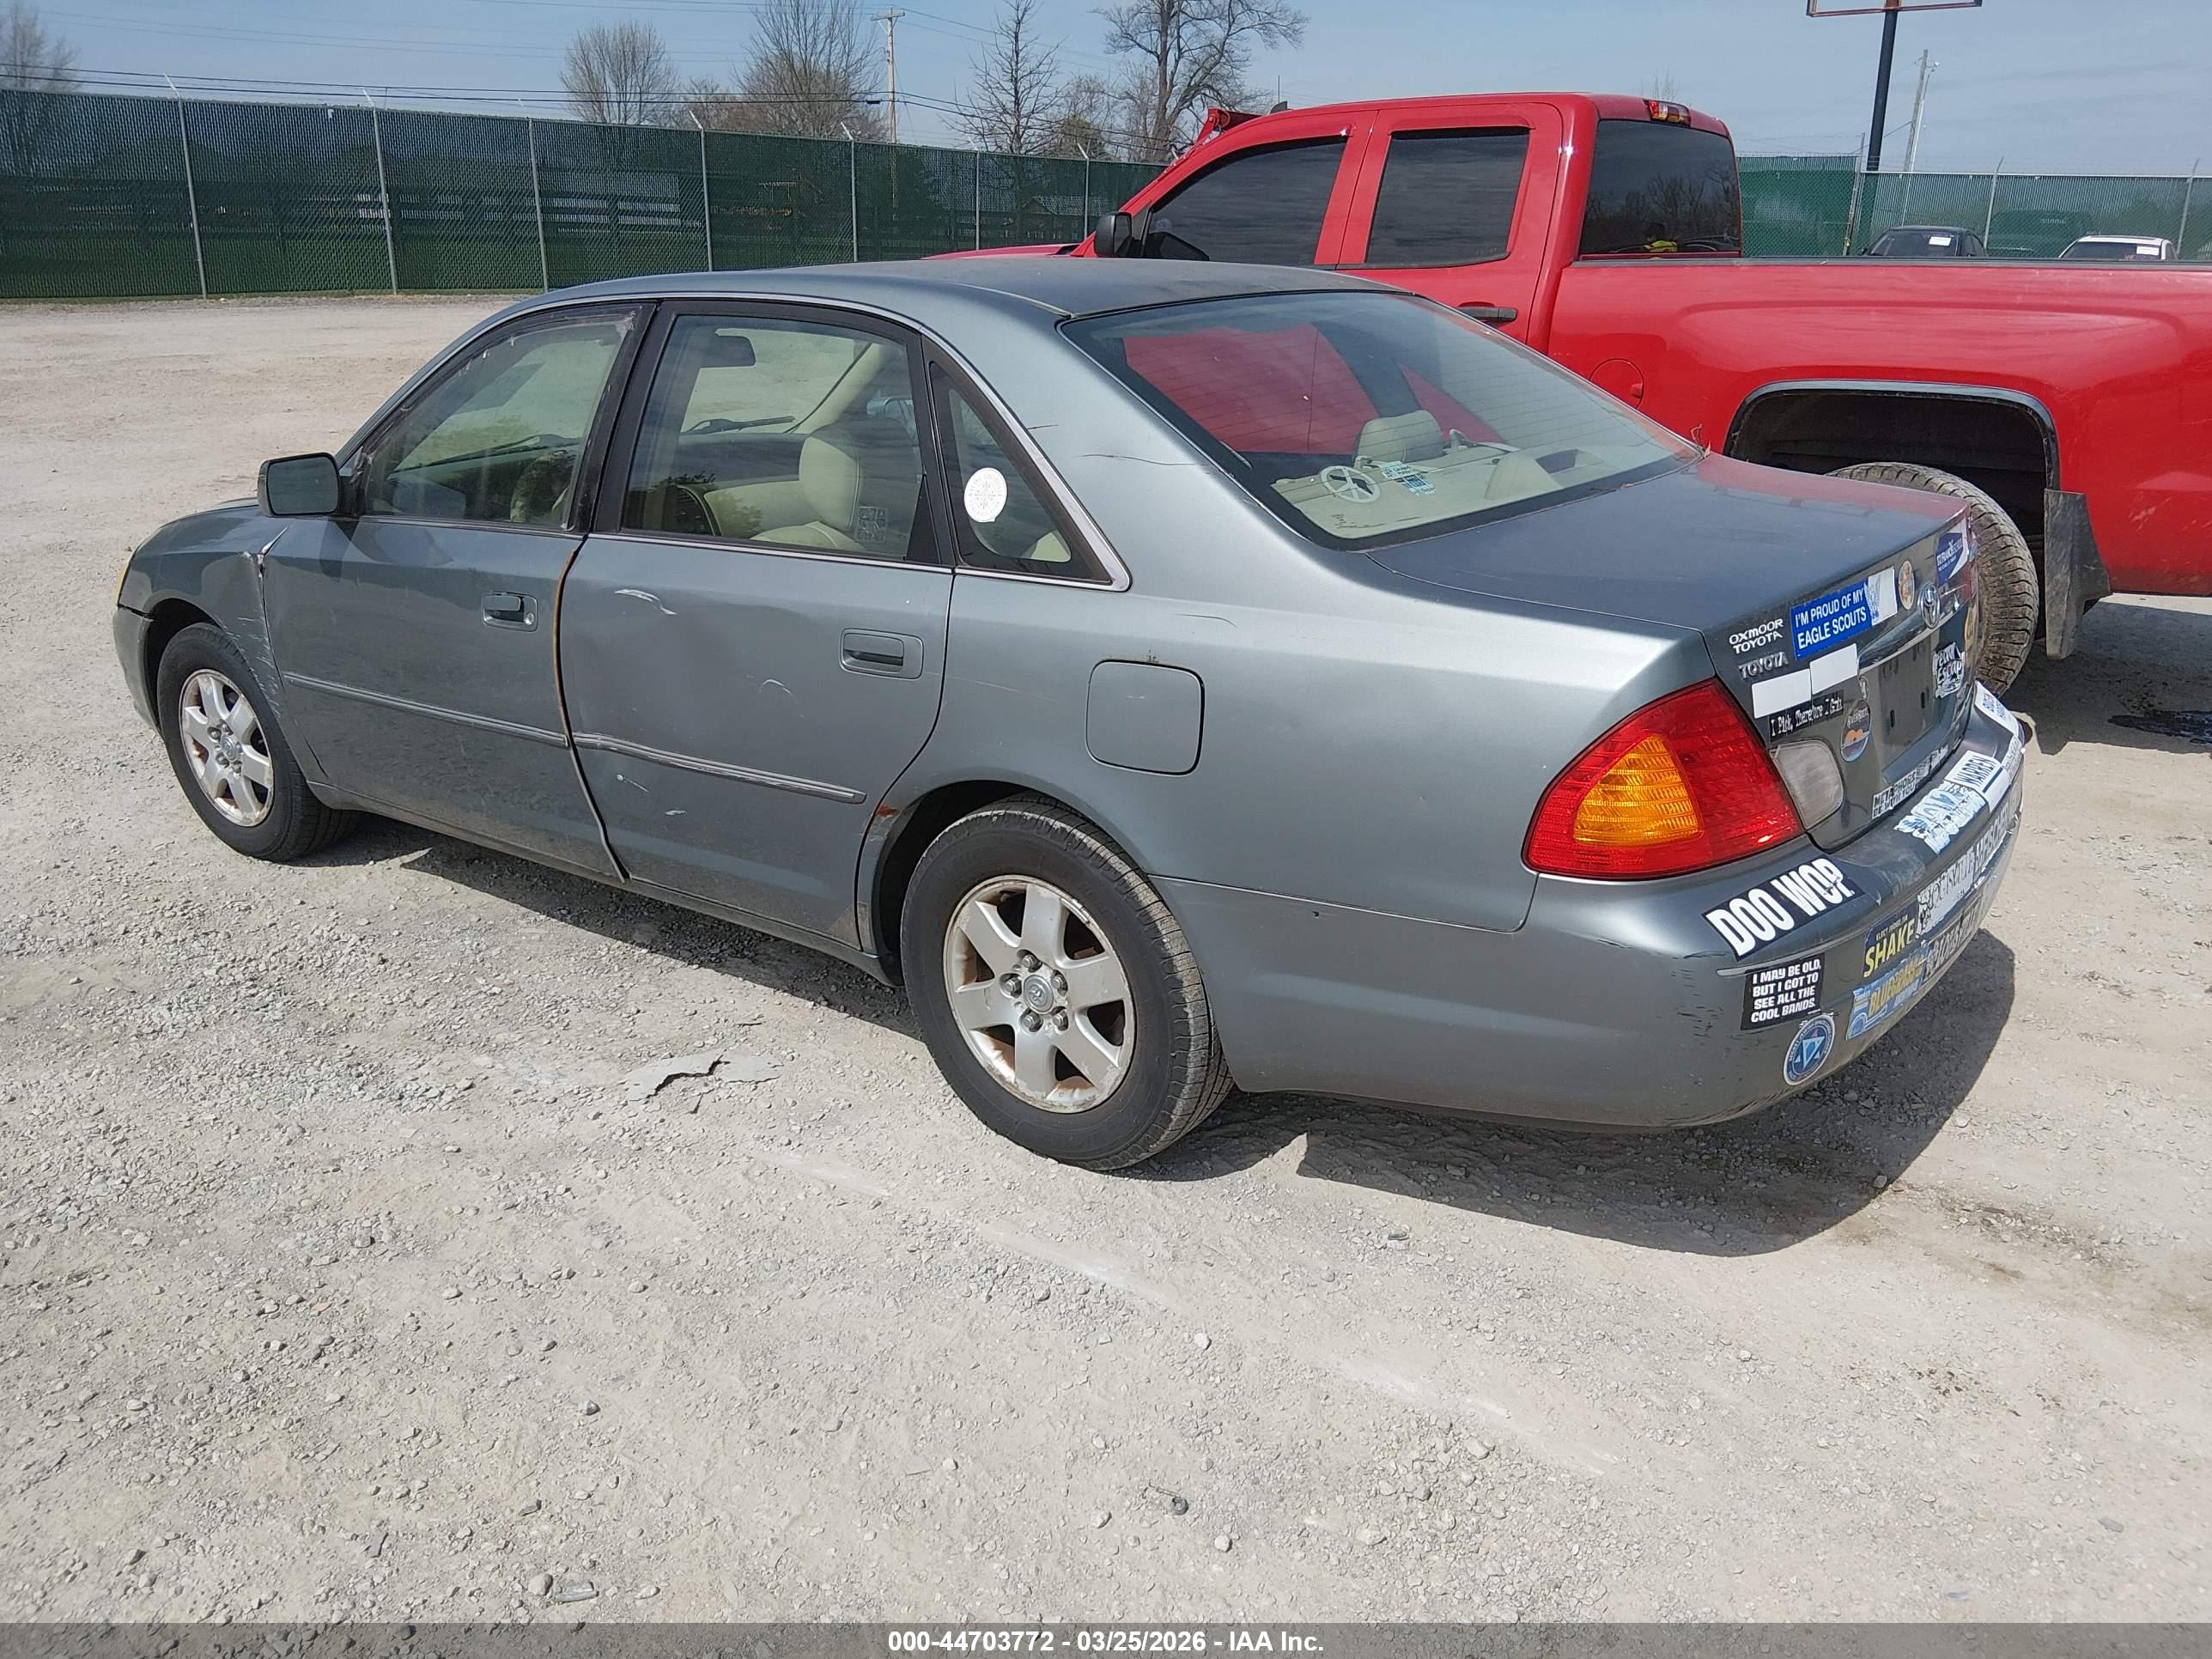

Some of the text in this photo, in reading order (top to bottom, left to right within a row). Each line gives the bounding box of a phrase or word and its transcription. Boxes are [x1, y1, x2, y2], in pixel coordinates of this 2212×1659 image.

[1795, 587, 1864, 629] I'M PROUD OF MY
[1729, 617, 1784, 645] OXMOOR
[1797, 605, 1867, 650] EAGLE SCOUTS
[1733, 630, 1783, 654] TOYOTA
[1738, 651, 1790, 679] TOYOTA
[1771, 720, 1776, 737] I
[1954, 750, 1998, 787] WARREN
[1705, 888, 1795, 957] DOO
[1863, 917, 1916, 978] SHAKE
[1753, 958, 1821, 985] I MAY BE OLD,
[1753, 972, 1819, 998] BUT I GOT TO
[1753, 985, 1816, 1010] SEE ALL THE
[1750, 1008, 1780, 1023] COOL
